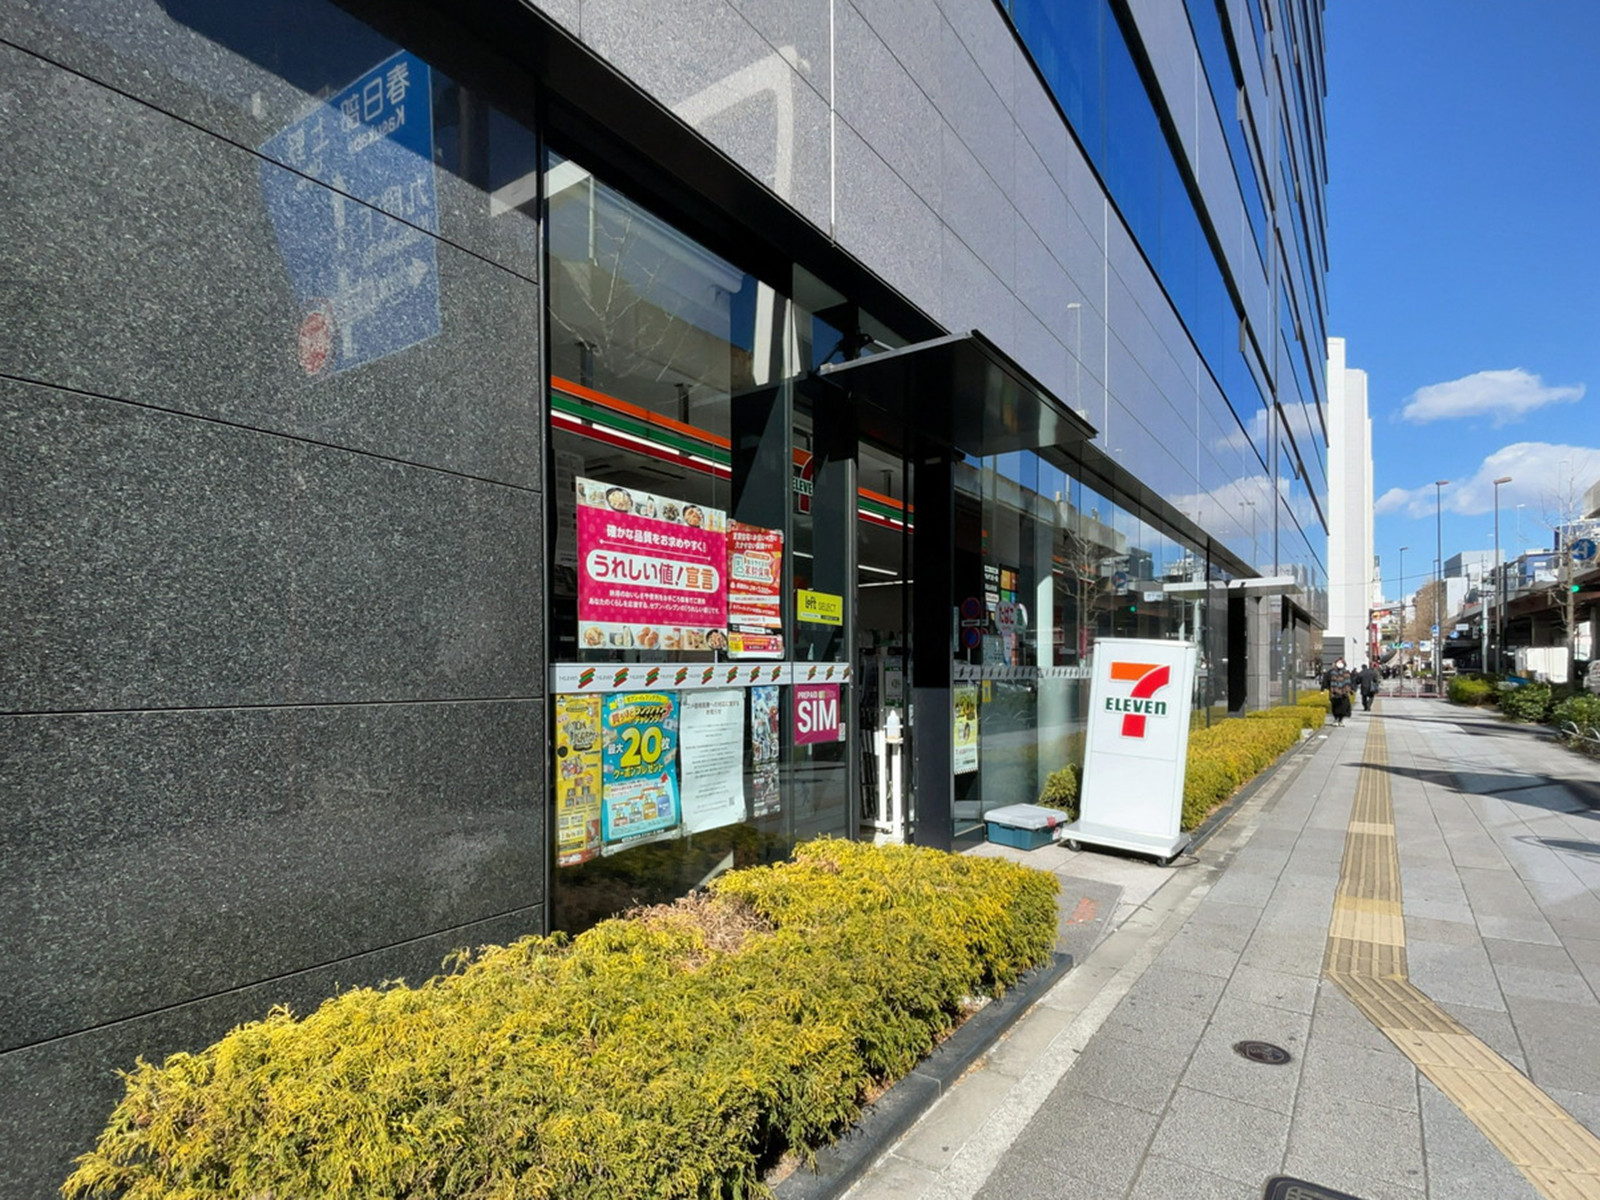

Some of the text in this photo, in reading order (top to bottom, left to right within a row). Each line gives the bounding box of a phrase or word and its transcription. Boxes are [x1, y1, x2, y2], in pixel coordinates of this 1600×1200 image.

[594, 554, 714, 590] うれしい値!宣言
[797, 699, 837, 734] SIM
[1109, 661, 1171, 739] 7
